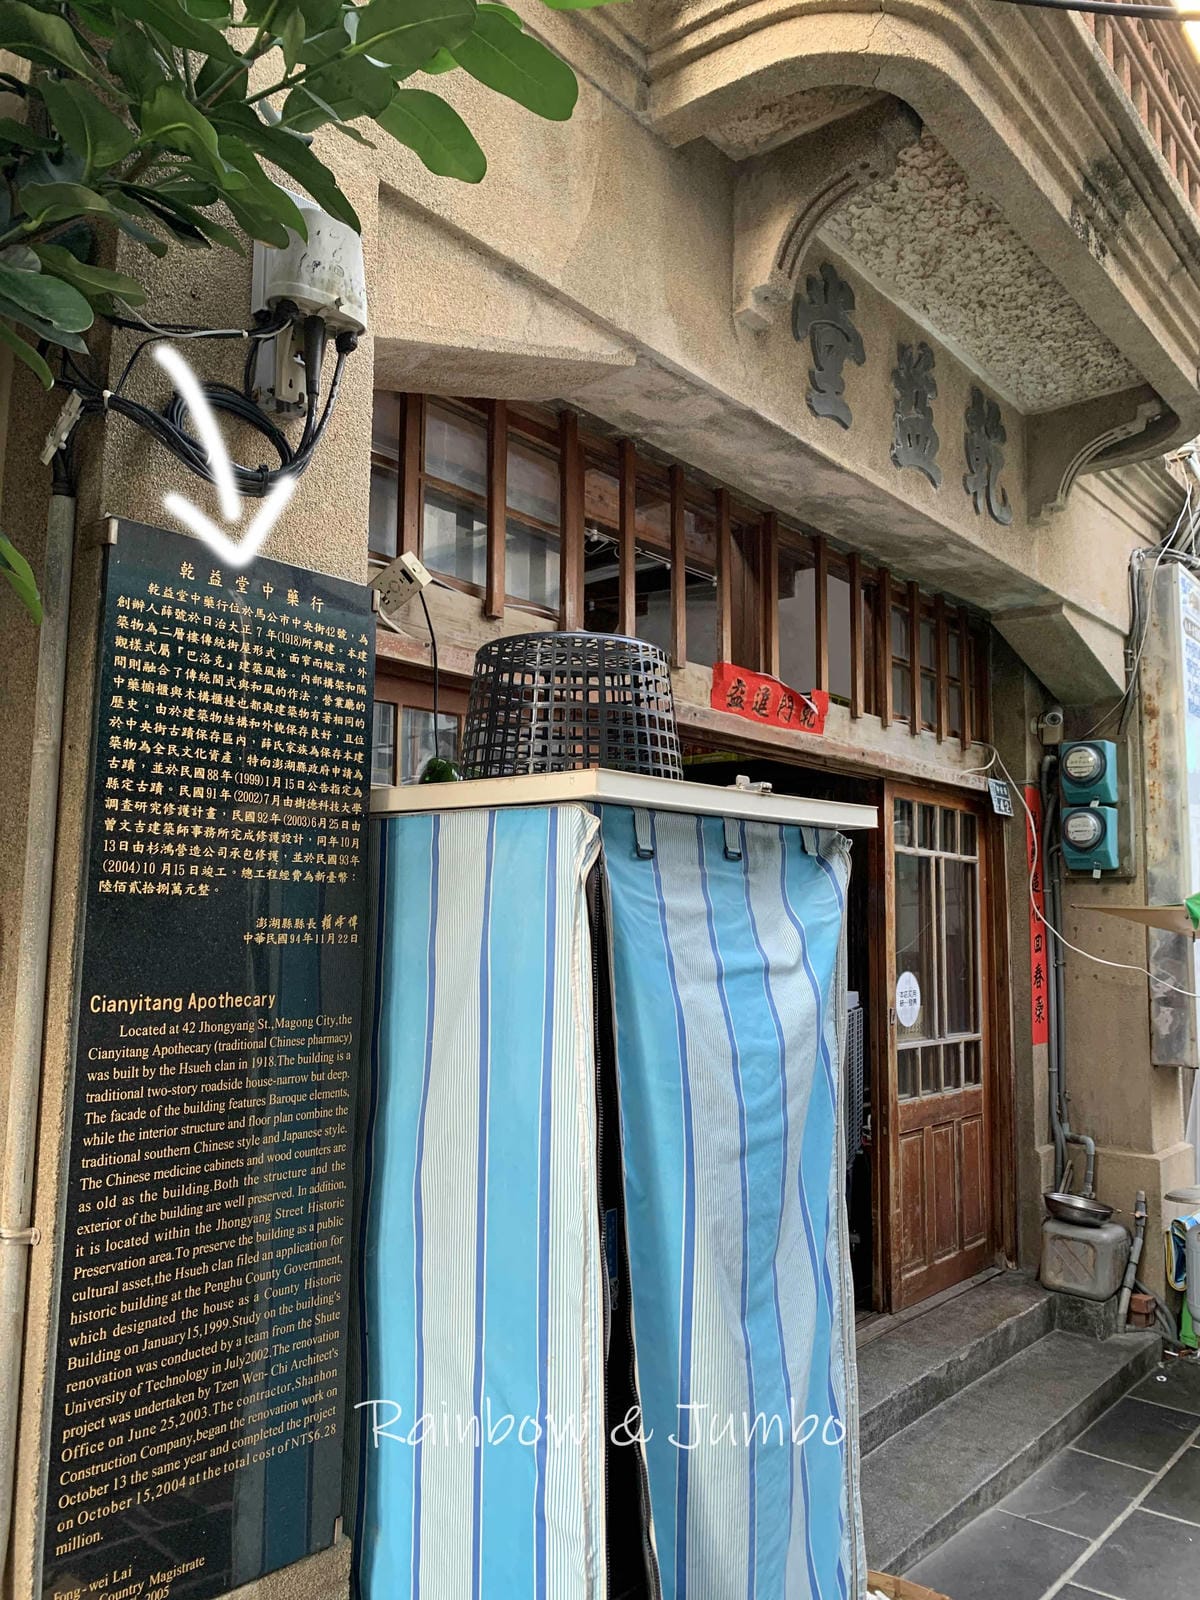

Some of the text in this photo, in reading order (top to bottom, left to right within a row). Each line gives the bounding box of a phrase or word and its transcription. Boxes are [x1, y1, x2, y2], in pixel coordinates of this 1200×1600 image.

[179, 561, 326, 614] 乾益堂中藥行
[255, 916, 316, 929] 澎湖縣縣長
[90, 992, 276, 1015] Cianyitang Apothecary
[87, 1031, 352, 1061] Cianyitang Apothecary (traditional Chinese pharmacy)
[119, 1022, 166, 1037] Located
[168, 1023, 179, 1034] at
[182, 1021, 195, 1033] 42
[198, 1020, 254, 1034] Jhongyang
[85, 1085, 143, 1103] traditional
[147, 1084, 198, 1097] two-story
[200, 1077, 242, 1092] roadside
[245, 1074, 308, 1088] house-narrow
[310, 1070, 324, 1081] but
[82, 1104, 348, 1146] while the interior structure and floor plan combine the
[83, 1111, 106, 1125] The
[110, 1106, 146, 1122] facade
[149, 1104, 163, 1118] of
[164, 1103, 180, 1116] the
[183, 1099, 225, 1114] building
[228, 1097, 266, 1109] features
[269, 1093, 307, 1105] Baroque
[79, 1143, 346, 1190] The Chinese medicine cabinets and wood counters are
[81, 1148, 140, 1168] traditional
[143, 1144, 190, 1160] southern
[193, 1139, 234, 1153] Chinese
[236, 1134, 260, 1149] style
[262, 1130, 279, 1144] and
[281, 1128, 322, 1143] Japanese
[75, 1196, 344, 1257] it is located within the Jhongyang Street Historic
[76, 1217, 122, 1235] exterior
[124, 1212, 138, 1226] of
[139, 1210, 157, 1224] the
[159, 1203, 203, 1220] building
[205, 1201, 221, 1212] are
[224, 1194, 244, 1208] well
[297, 1184, 306, 1196] In
[71, 1279, 118, 1302] cultural
[174, 1261, 208, 1280] Hsueh
[211, 1258, 233, 1271] clan
[236, 1250, 259, 1266] filed
[261, 1251, 273, 1260] an
[276, 1238, 327, 1260] application
[330, 1234, 343, 1246] for
[68, 1327, 106, 1347] which
[112, 1309, 176, 1336] designated
[181, 1306, 198, 1320] the
[202, 1299, 234, 1315] house
[238, 1295, 249, 1305] as
[263, 1283, 299, 1299] County
[304, 1273, 341, 1289] Historic
[70, 1303, 116, 1325] historic
[120, 1293, 168, 1313] building
[170, 1290, 181, 1301] at
[184, 1285, 201, 1298] the
[204, 1275, 242, 1294] Penghu
[245, 1268, 281, 1284] County
[65, 1367, 131, 1393] renovation
[135, 1360, 157, 1374] was
[160, 1340, 217, 1367] conducted
[220, 1338, 233, 1352] by
[244, 1330, 268, 1344] team
[272, 1323, 294, 1336] from
[297, 1317, 312, 1329] the
[314, 1311, 340, 1325] Shute
[62, 1416, 104, 1443] project
[108, 1411, 130, 1425] was
[134, 1392, 194, 1418] undertaken
[197, 1386, 210, 1400] by
[213, 1378, 238, 1393] Tzen
[270, 1360, 287, 1376] Chi
[290, 1347, 338, 1371] Architect's
[58, 1405, 335, 1508] October 13 the same year and completed the project
[55, 1534, 104, 1556] million.
[112, 1564, 132, 1584] Lai
[149, 1555, 205, 1584] Magistrate
